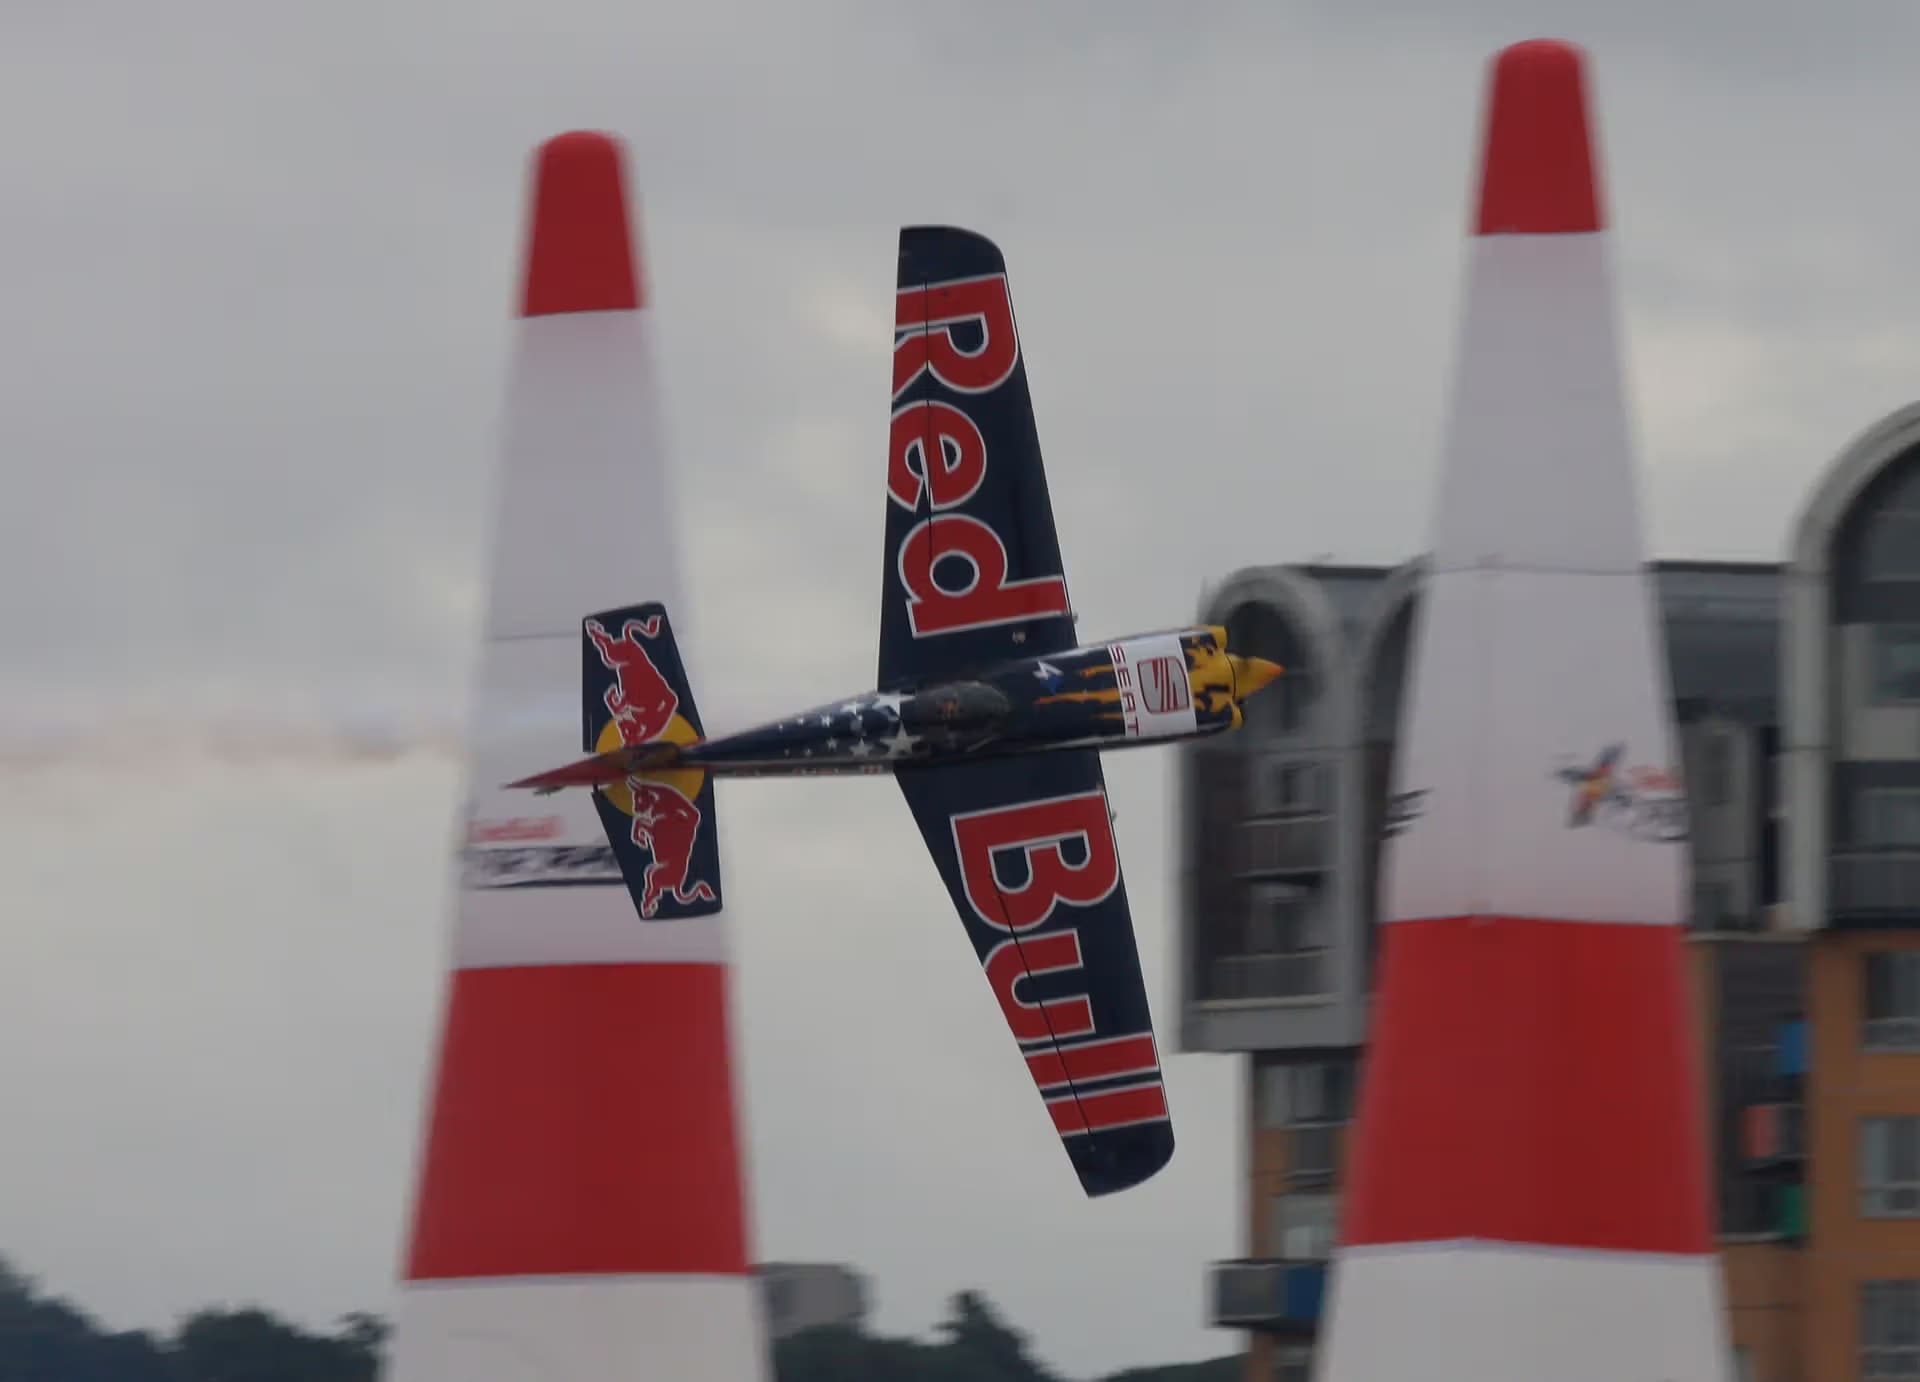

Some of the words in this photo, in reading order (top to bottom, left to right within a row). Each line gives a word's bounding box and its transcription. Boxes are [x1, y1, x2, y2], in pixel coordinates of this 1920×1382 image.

[887, 272, 1071, 639] Red
[1109, 643, 1140, 737] SEAT
[949, 790, 1169, 1137] Bull
